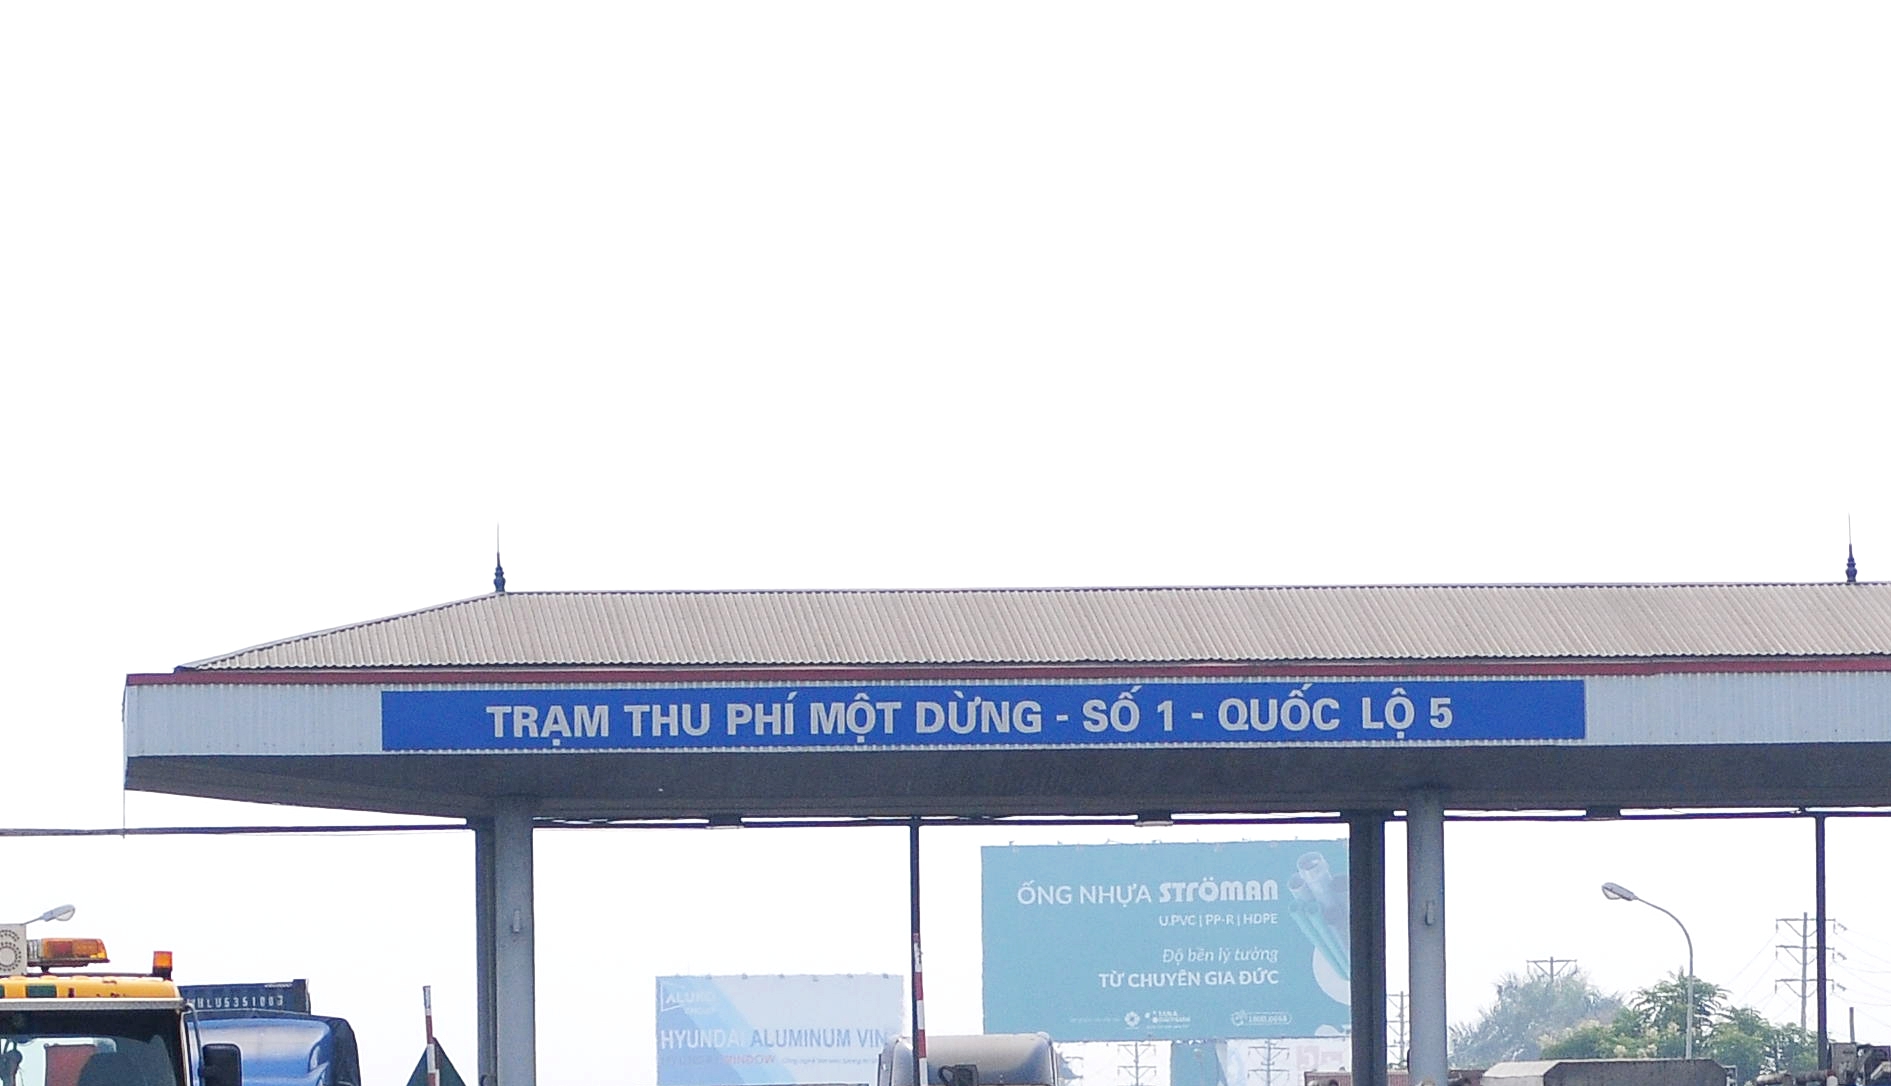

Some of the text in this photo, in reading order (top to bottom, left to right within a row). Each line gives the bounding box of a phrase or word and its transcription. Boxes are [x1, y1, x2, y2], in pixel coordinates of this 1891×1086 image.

[486, 705, 609, 747] TRẠM
[624, 703, 711, 737] THU
[727, 691, 797, 736] PHÍ
[809, 693, 901, 743] MỘT
[916, 690, 1042, 734] DỪNG
[1082, 685, 1142, 733] SỐ
[1156, 700, 1174, 731] 1
[1217, 683, 1340, 732] QUỐC
[1361, 688, 1415, 739] LỘ
[1429, 697, 1453, 730] 5
[1017, 877, 1278, 908] ỐNG NHỰA STRÖMAN
[1205, 913, 1235, 926] PP-R
[1243, 912, 1279, 925] HDPE
[1127, 968, 1200, 988] CHUYÊN
[1204, 971, 1235, 986] GIA
[1238, 967, 1279, 985] ĐỨC
[751, 1028, 850, 1049] ALUMINUM
